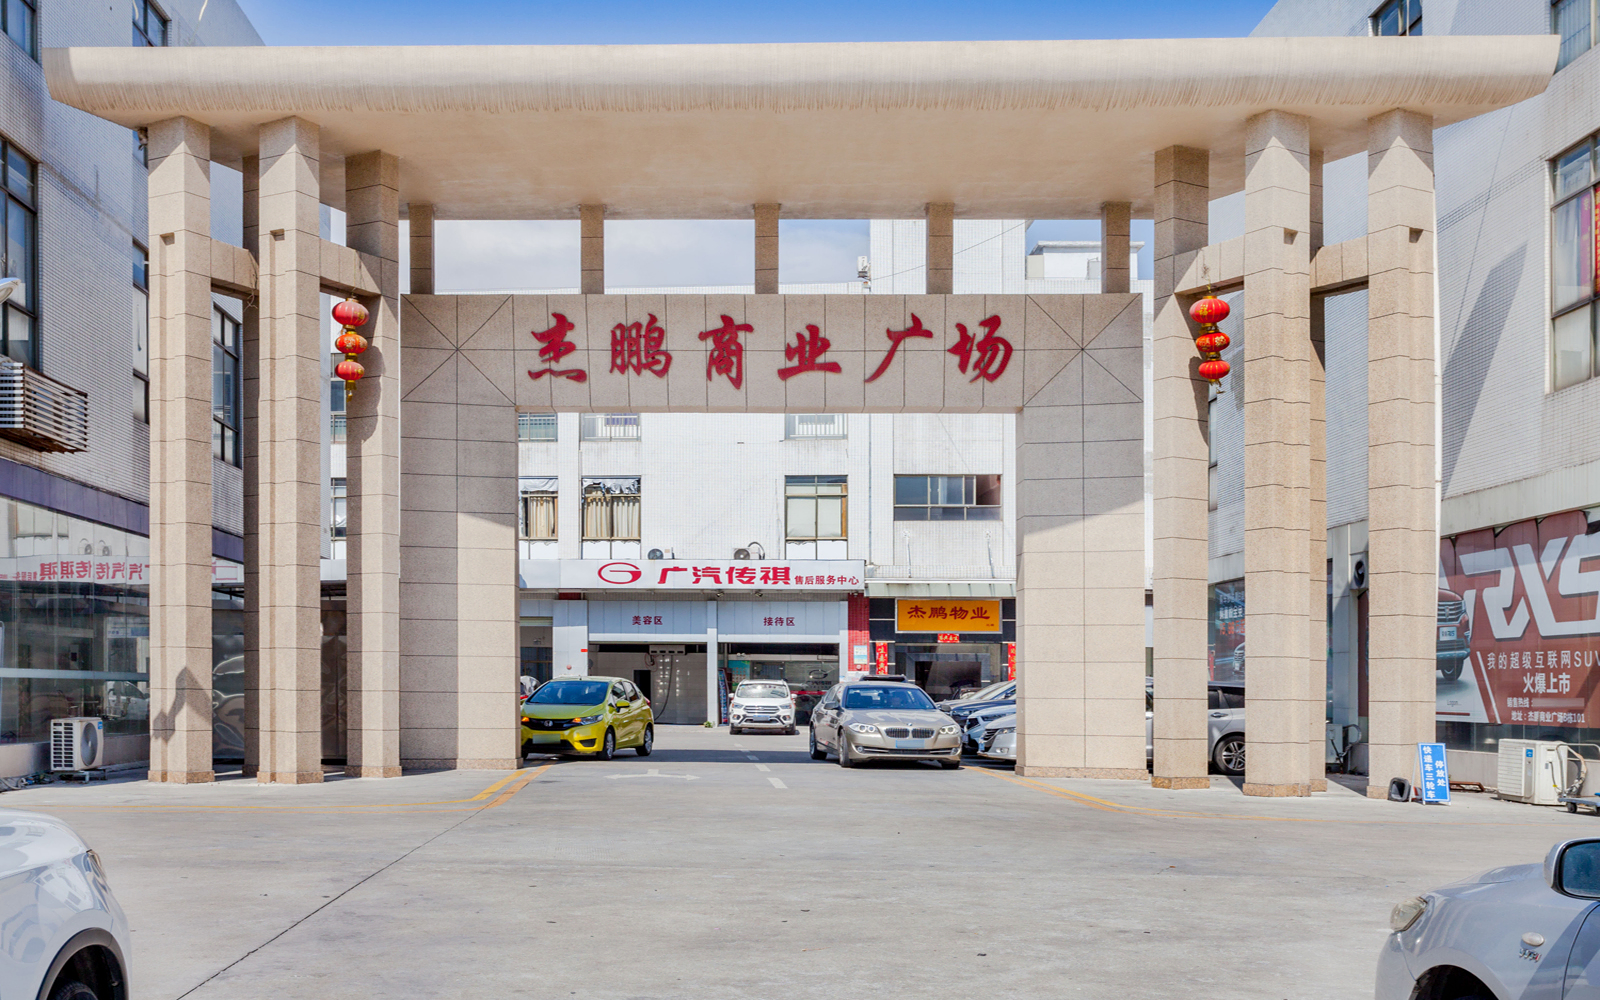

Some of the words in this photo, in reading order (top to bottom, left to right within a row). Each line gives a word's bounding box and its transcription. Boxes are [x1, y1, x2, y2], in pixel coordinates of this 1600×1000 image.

[527, 312, 1014, 389] 杰鹏商业广场
[657, 566, 791, 585] 广汽传祺
[794, 575, 860, 586] 售后服务中心
[632, 615, 663, 626] 美容区
[763, 616, 795, 627] 接待区
[907, 605, 990, 620] 杰鹏物业
[1522, 672, 1571, 695] 火爆上市
[1422, 745, 1436, 799] 快递车三轮车
[1434, 760, 1447, 787] 停放处
